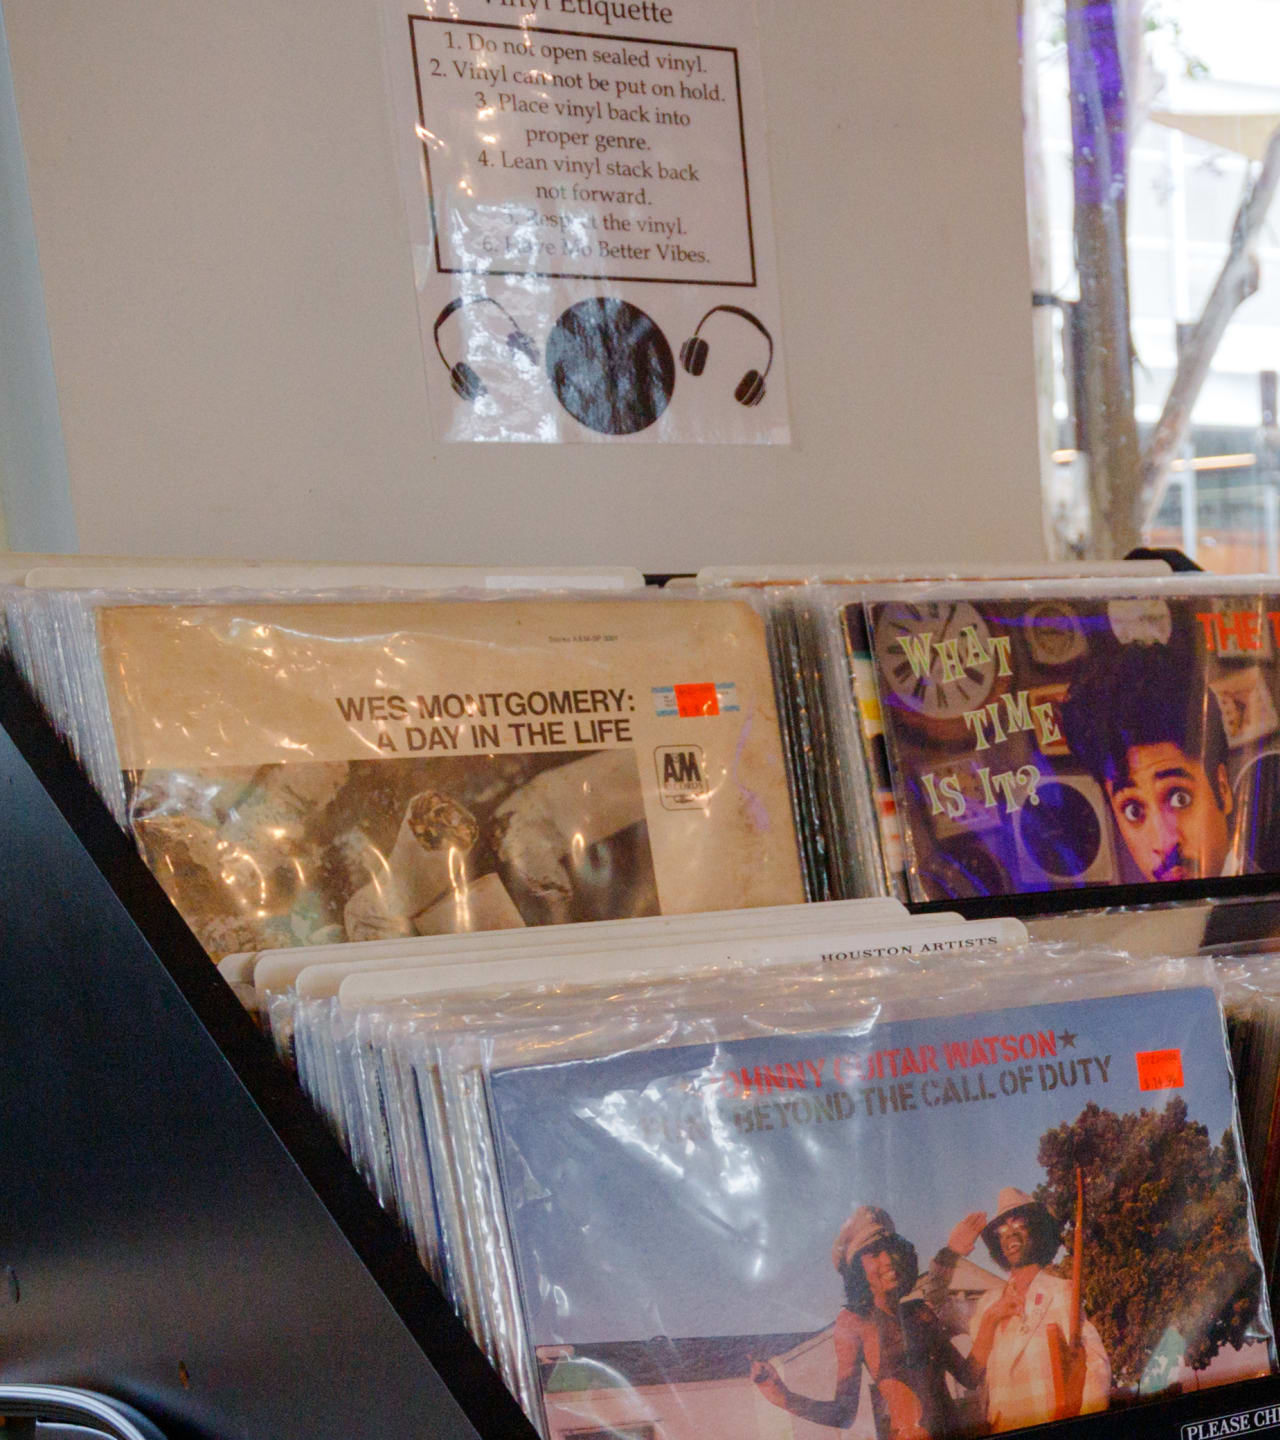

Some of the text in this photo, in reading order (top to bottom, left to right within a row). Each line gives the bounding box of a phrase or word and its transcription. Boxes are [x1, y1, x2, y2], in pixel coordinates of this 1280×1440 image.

[445, 32, 707, 73] 1. Do not open sealed vinyl.
[430, 58, 726, 102] 2. Vinyl can not be put on hold.
[475, 91, 692, 127] 3 Place vinyl back into
[526, 127, 652, 152] proper genre.
[478, 149, 700, 182] 4. Lean vinyl stack back
[535, 183, 652, 206] not forward.
[527, 207, 597, 233] Respt
[602, 212, 632, 232] the
[637, 216, 688, 239] vinyl.
[597, 240, 652, 260] Better
[656, 244, 711, 264] Vibes.
[1197, 610, 1263, 651] THE
[900, 623, 1013, 685] WHAT
[336, 694, 407, 722] WES
[416, 688, 636, 720] MONTGOMERY:
[963, 689, 1062, 750] TIME
[377, 718, 633, 752] A DAY IN THE LIFE
[921, 764, 1042, 820] IS IT?
[821, 935, 998, 963] HOUSTON ARTISTS
[702, 1029, 1058, 1099] OHNNY GUITAR WATSON
[733, 1092, 857, 1135] BEYOND
[859, 1082, 920, 1117] THE
[920, 1068, 997, 1107] CALL
[1000, 1064, 1035, 1097] OF
[1038, 1053, 1114, 1092] DUTY
